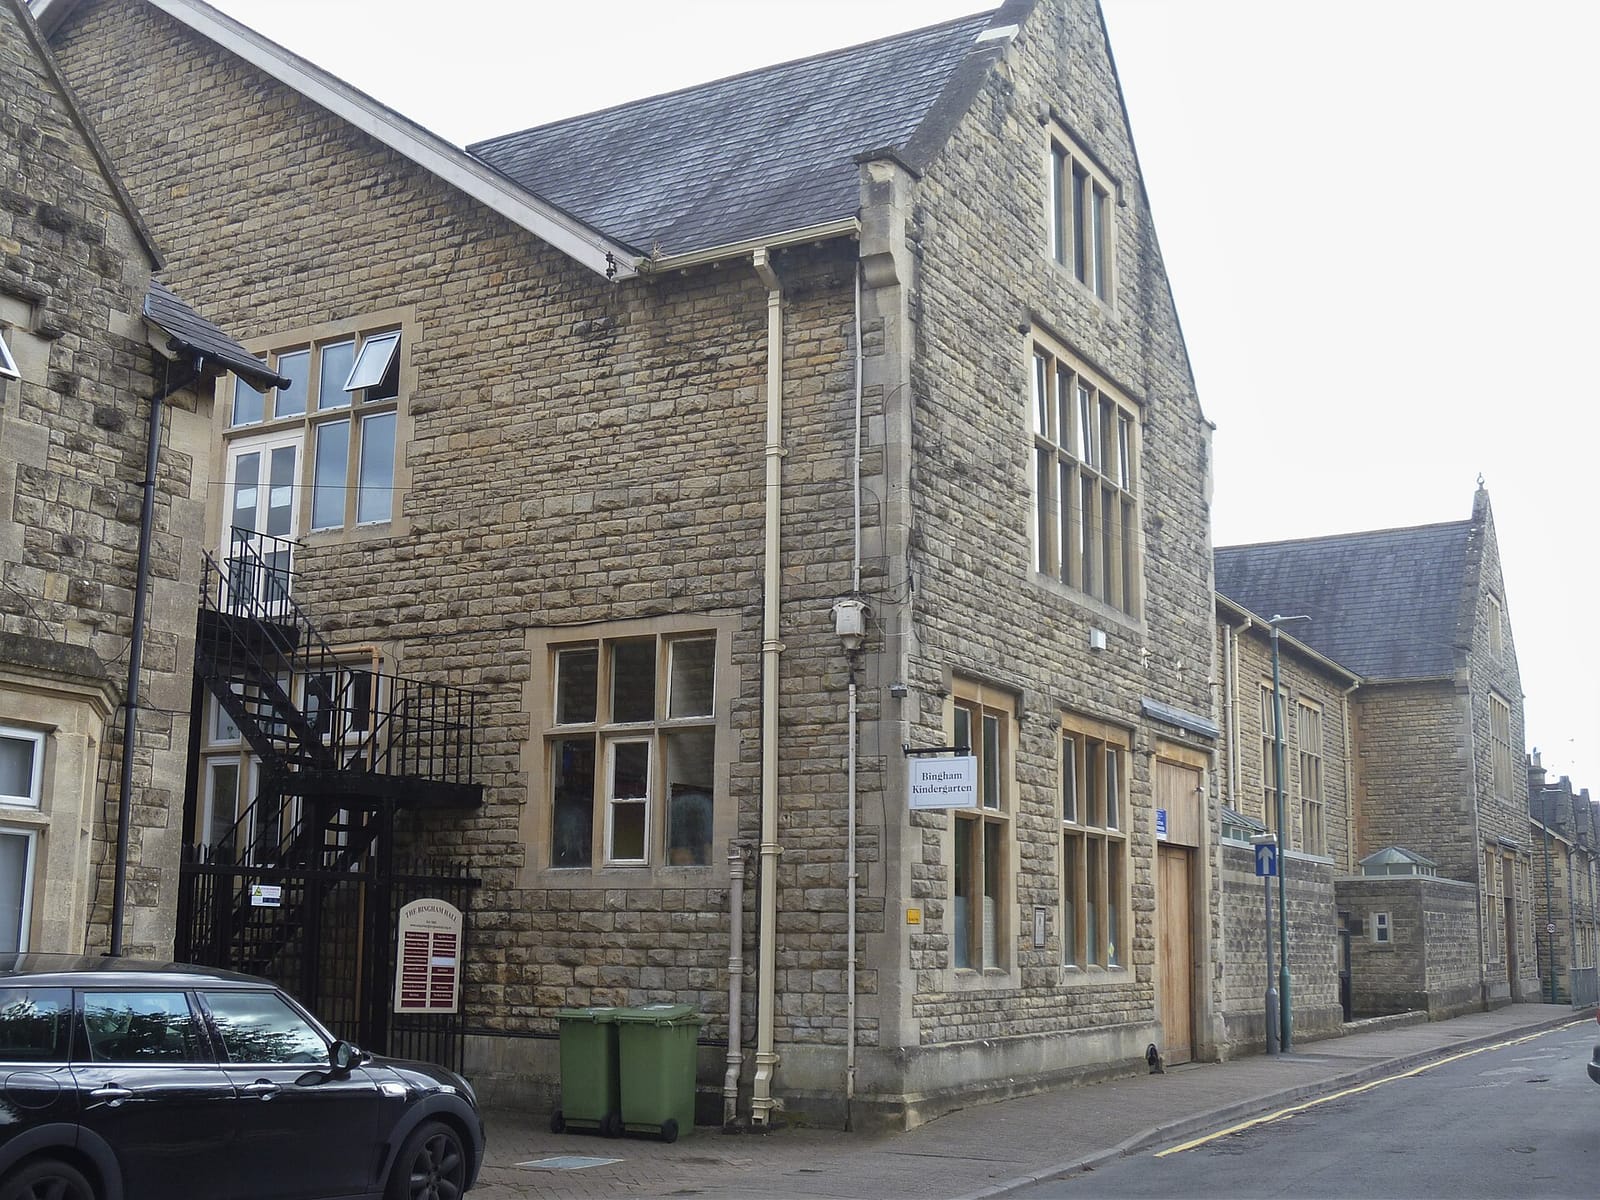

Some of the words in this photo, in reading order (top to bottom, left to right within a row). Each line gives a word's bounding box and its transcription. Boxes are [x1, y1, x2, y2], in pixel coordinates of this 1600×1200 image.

[922, 771, 962, 782] Bingham
[912, 784, 972, 794] Kindergarten
[405, 908, 416, 919] THE
[417, 905, 444, 916] BINGHAM
[444, 908, 457, 923] HALL
